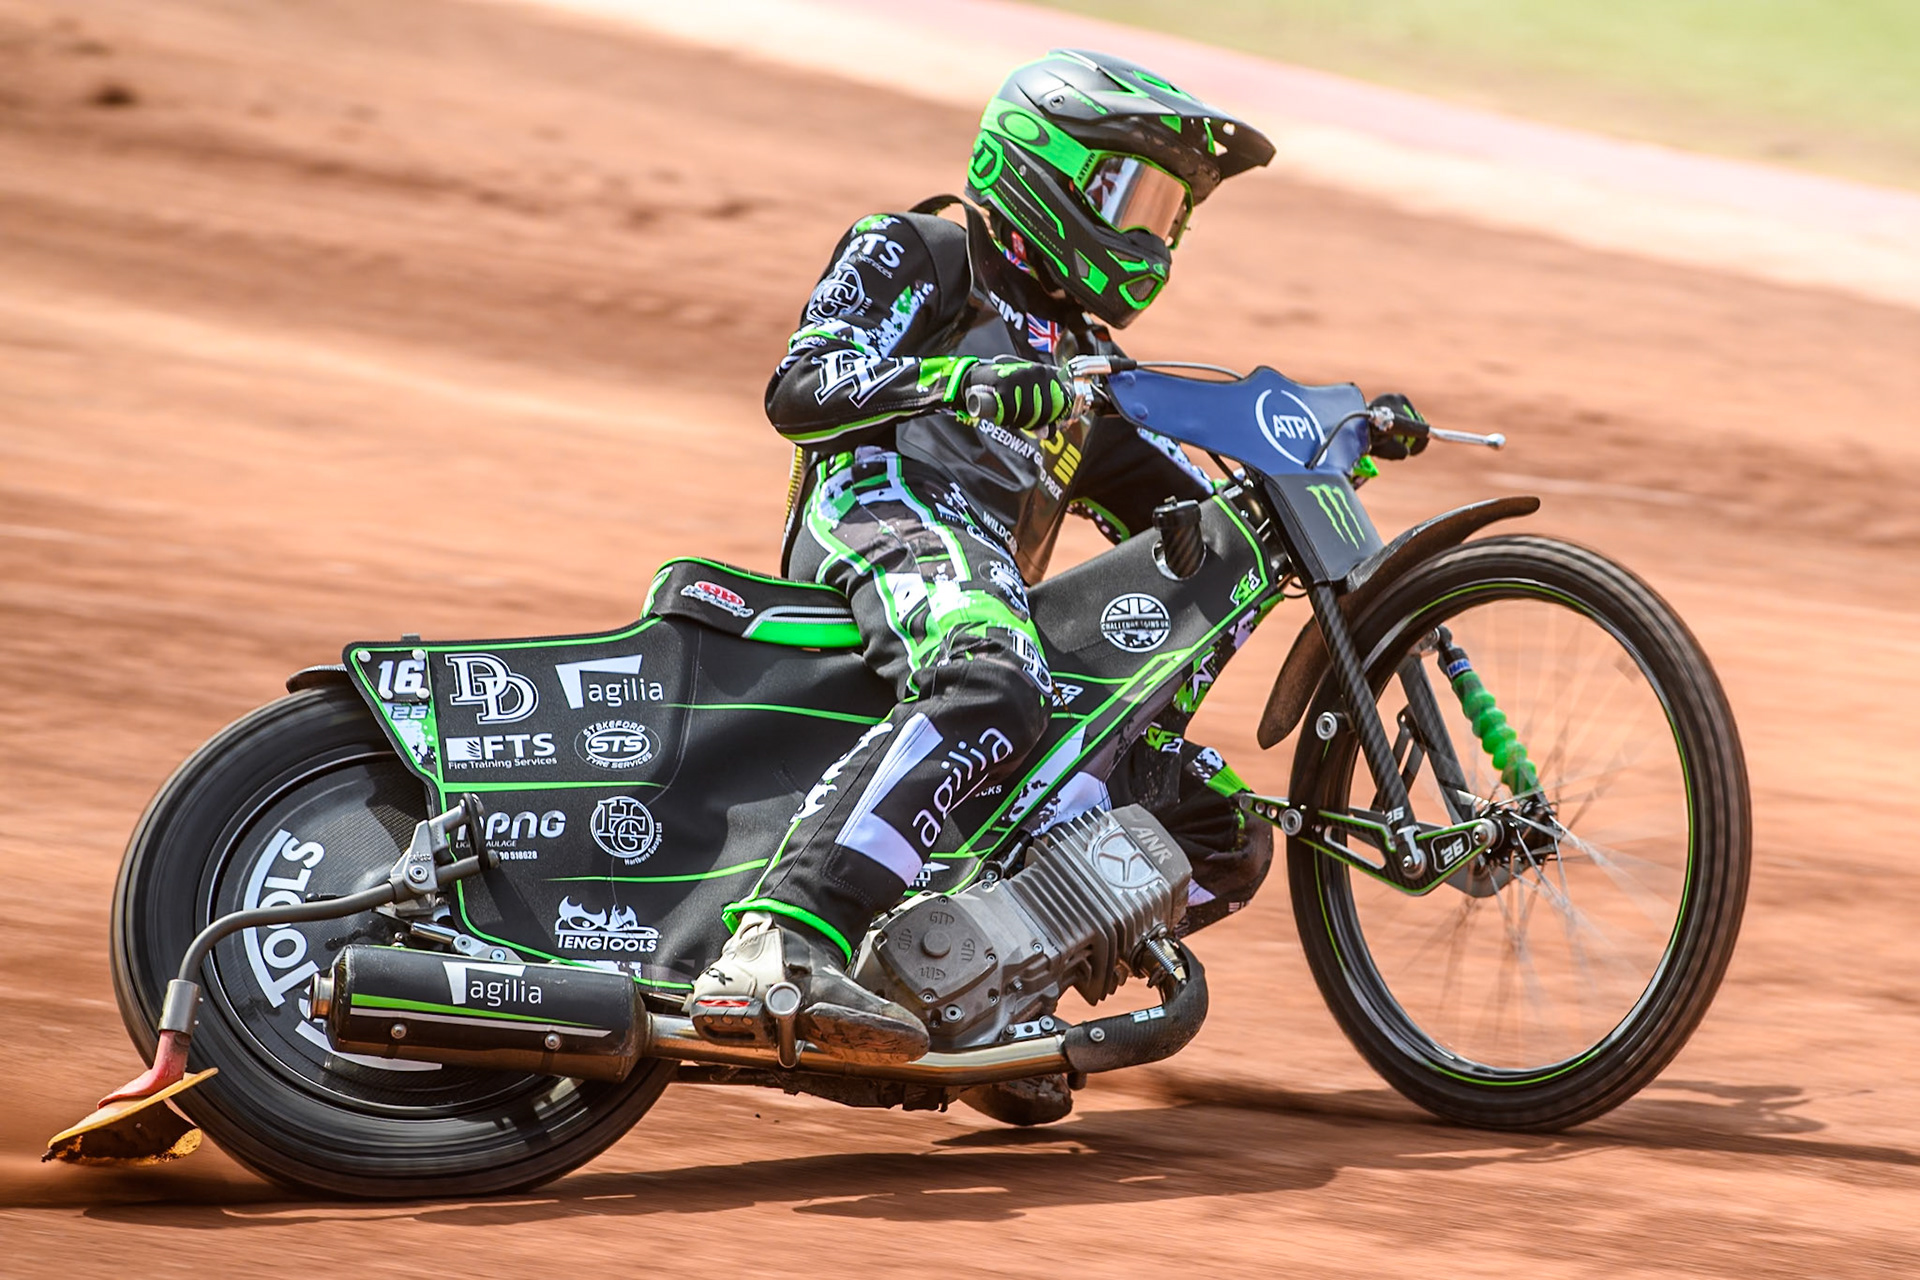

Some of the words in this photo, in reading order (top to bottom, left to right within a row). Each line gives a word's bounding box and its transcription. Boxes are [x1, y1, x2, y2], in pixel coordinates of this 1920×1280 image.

[1273, 414, 1316, 441] ATPI
[978, 419, 1035, 459] SPEEDWAY
[1044, 475, 1064, 501] PRIX
[378, 659, 426, 696] 16
[445, 653, 539, 725] DD
[588, 678, 664, 707] agilia
[391, 704, 429, 721] 26
[483, 733, 556, 760] FTS
[590, 736, 643, 753] STS
[448, 761, 467, 769] Fire
[470, 759, 512, 768] Training
[514, 757, 558, 766] Services
[586, 755, 610, 768] TYRE
[611, 751, 653, 769] SERVICES
[912, 727, 1014, 849] agilia
[1384, 806, 1405, 826] 26
[470, 978, 542, 1007] agilia
